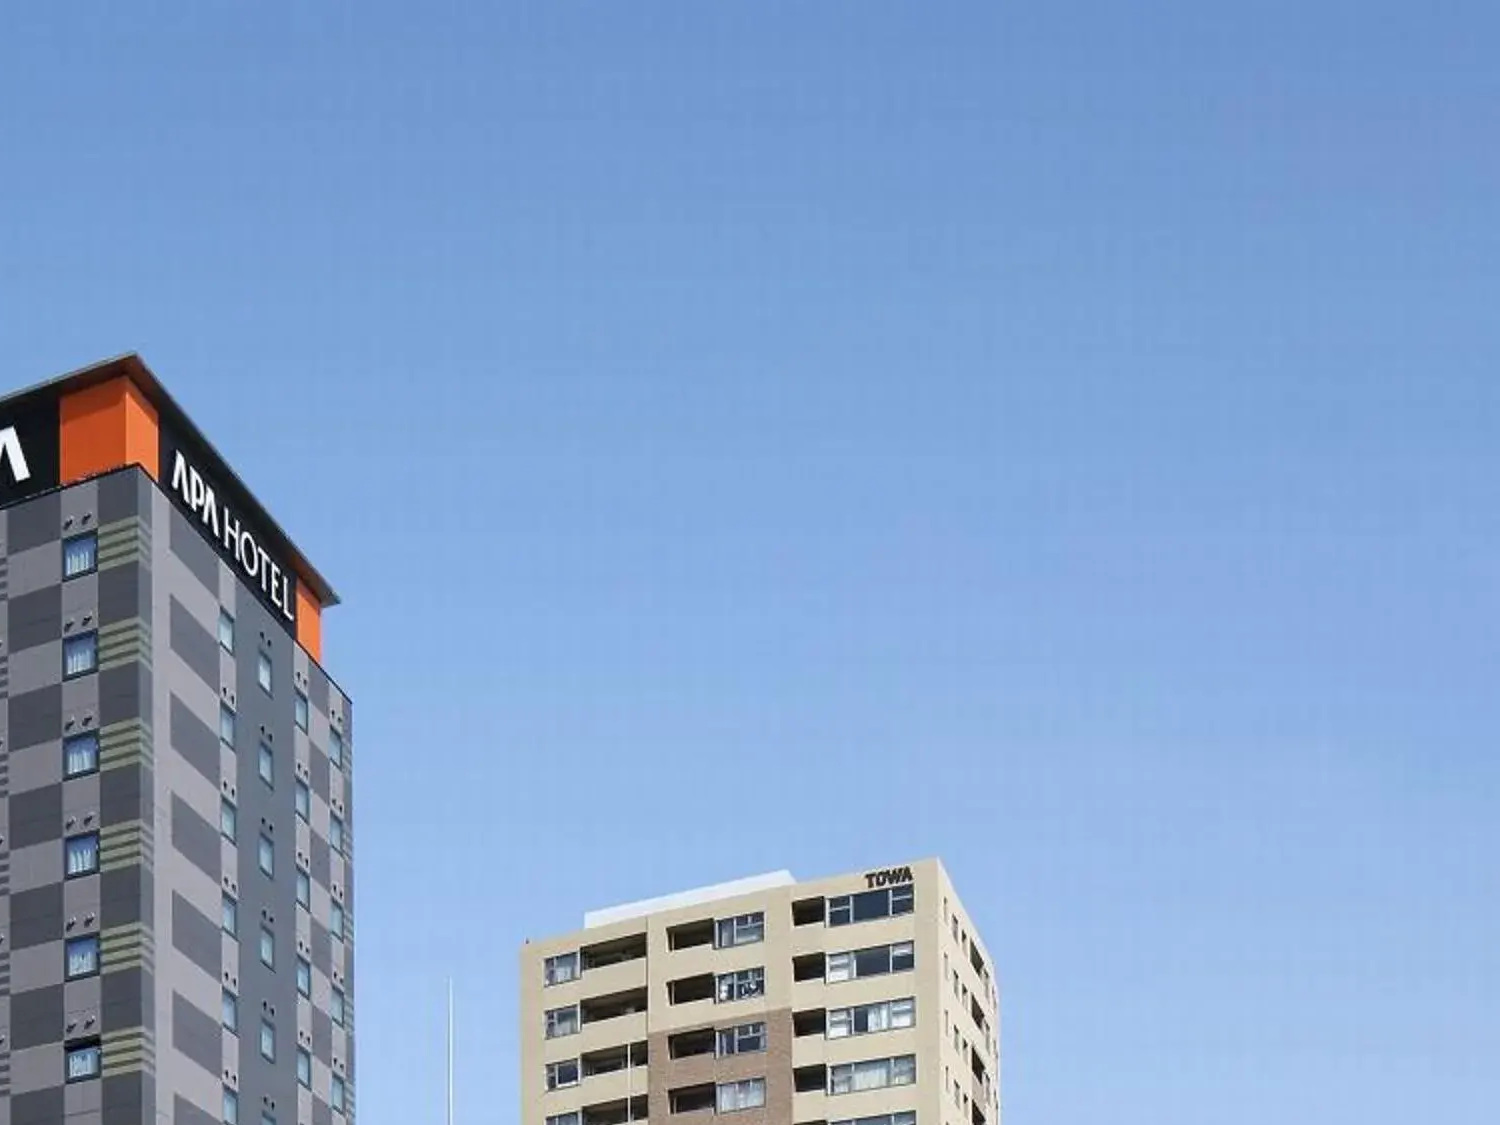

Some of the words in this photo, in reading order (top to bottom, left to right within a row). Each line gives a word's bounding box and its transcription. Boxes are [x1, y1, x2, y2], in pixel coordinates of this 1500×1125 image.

[171, 449, 220, 537] APA
[223, 506, 294, 621] HOTEL
[864, 865, 913, 889] TOWA
